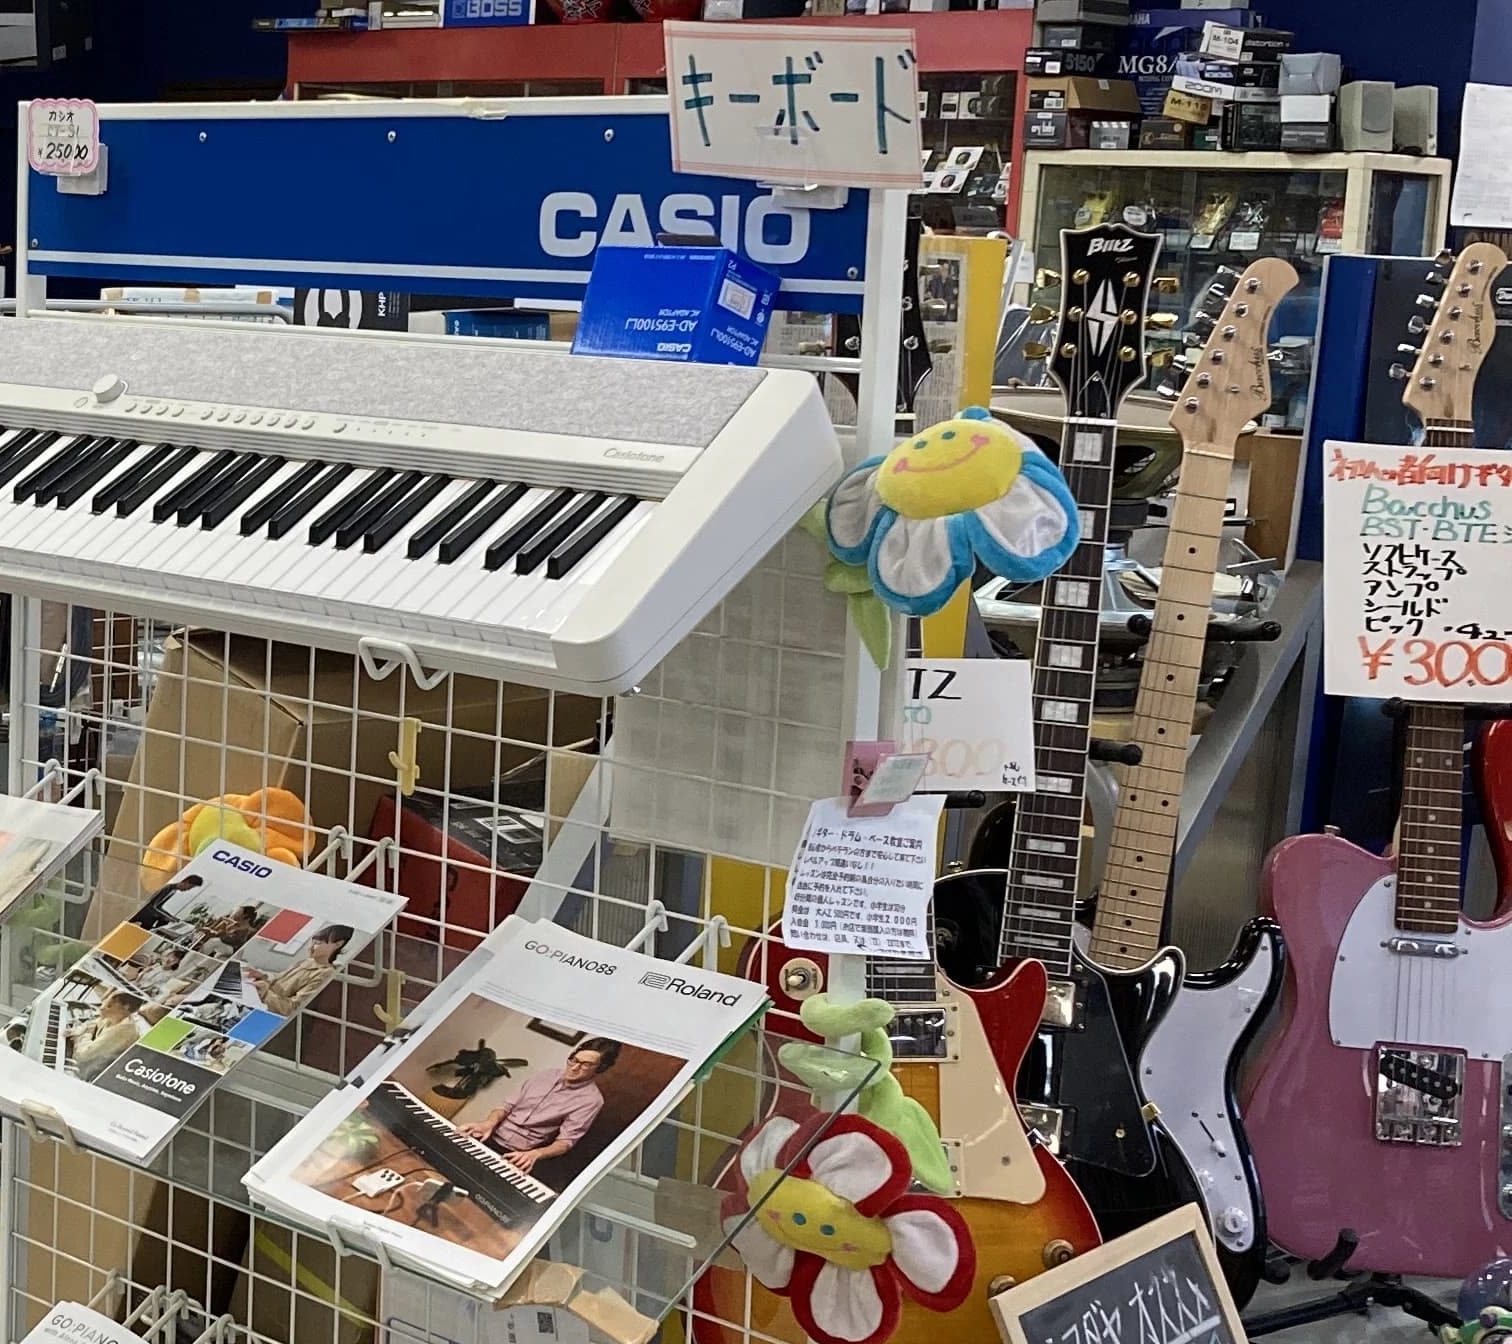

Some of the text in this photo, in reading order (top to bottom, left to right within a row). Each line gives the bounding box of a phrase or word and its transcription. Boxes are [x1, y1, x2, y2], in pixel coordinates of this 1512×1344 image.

[467, 0, 522, 17] BOSS
[1184, 81, 1223, 95] ZOOM
[683, 50, 915, 154] キーボード
[48, 110, 75, 123] カシオ
[539, 192, 810, 264] CASIO
[624, 317, 699, 333] AD-E95100LJ
[656, 342, 692, 353] CASIO
[1361, 484, 1492, 520] Bacchus
[1362, 560, 1468, 581] ストラップ
[1363, 580, 1440, 598] アンプ
[1364, 597, 1449, 618] シールド
[1366, 616, 1424, 637] ピック
[212, 850, 273, 879] CASIO
[524, 939, 742, 1008] GO:PIANO88 Roland
[124, 1058, 196, 1096] Casiotone
